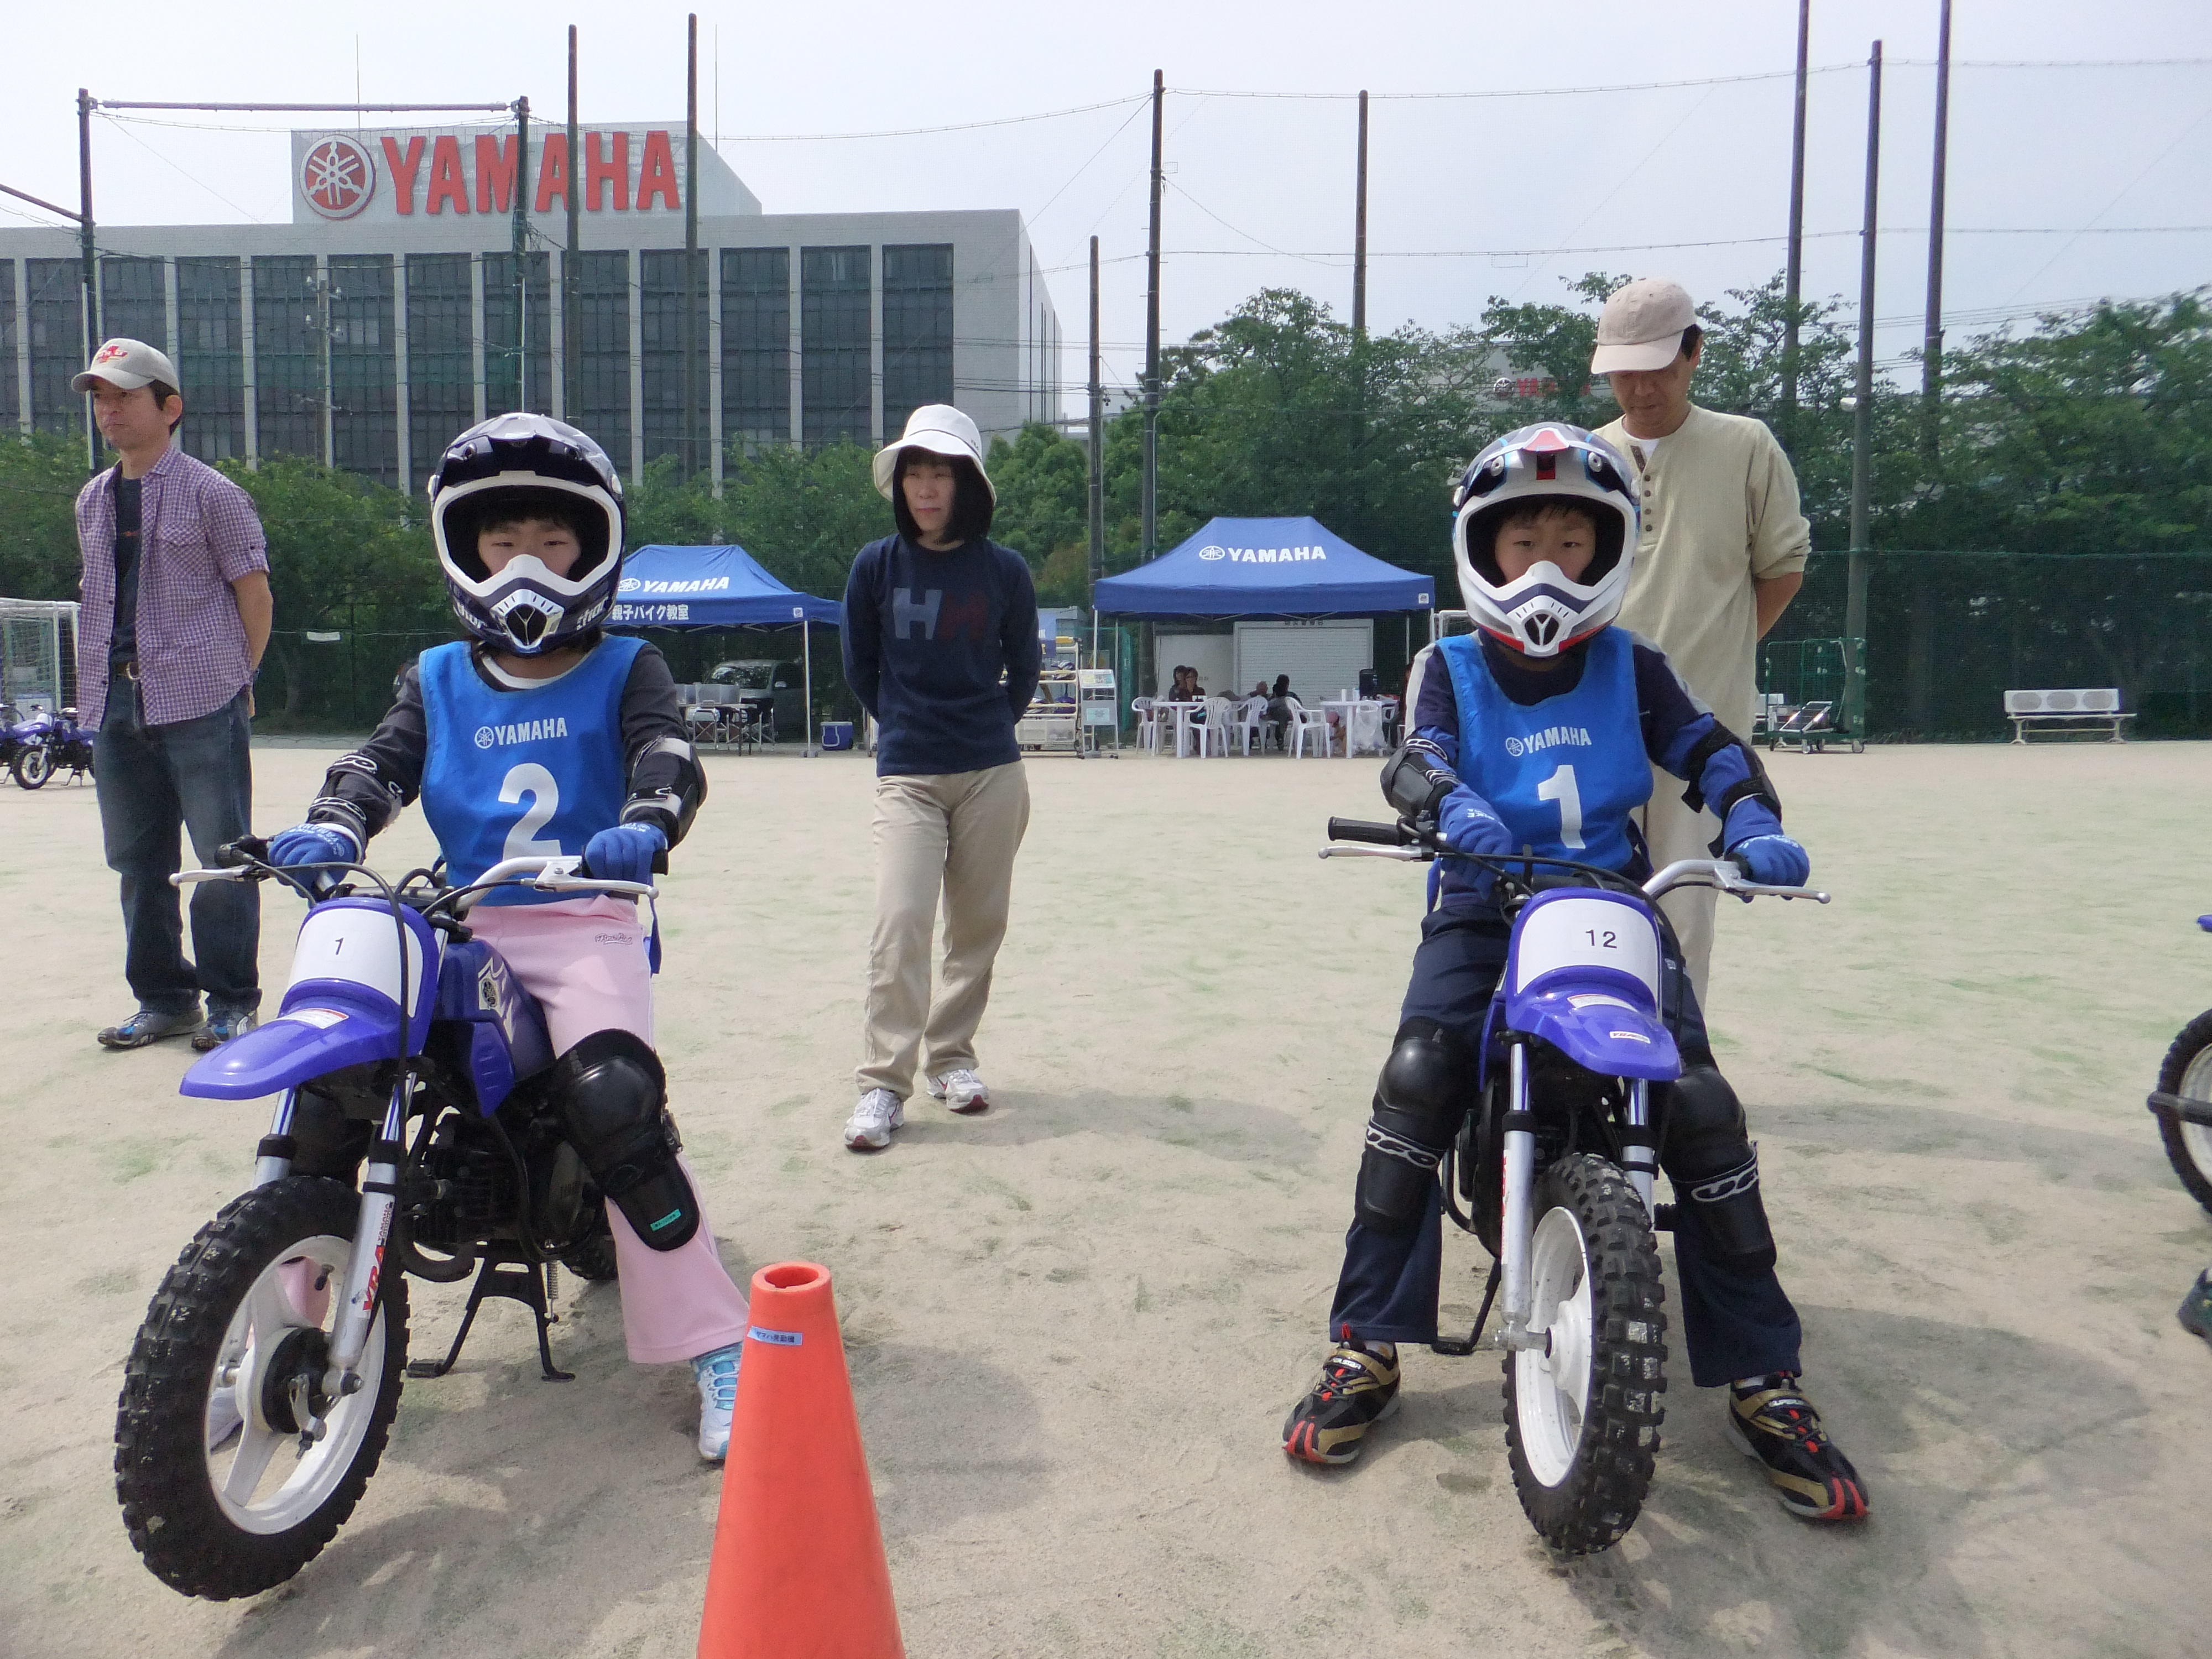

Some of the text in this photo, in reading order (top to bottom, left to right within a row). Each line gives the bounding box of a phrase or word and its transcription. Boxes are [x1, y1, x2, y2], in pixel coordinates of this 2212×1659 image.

[380, 131, 680, 215] YAMAHA
[1228, 546, 1326, 562] YAMAHA
[643, 577, 729, 593] YAMAHA
[612, 604, 689, 621] 親子バイク教室
[494, 717, 567, 745] YAMAHA
[1524, 727, 1592, 754] YAMAHA
[498, 763, 562, 863] 2
[1538, 765, 1586, 849] 1
[335, 937, 344, 955] 1
[1585, 930, 1618, 948] 12
